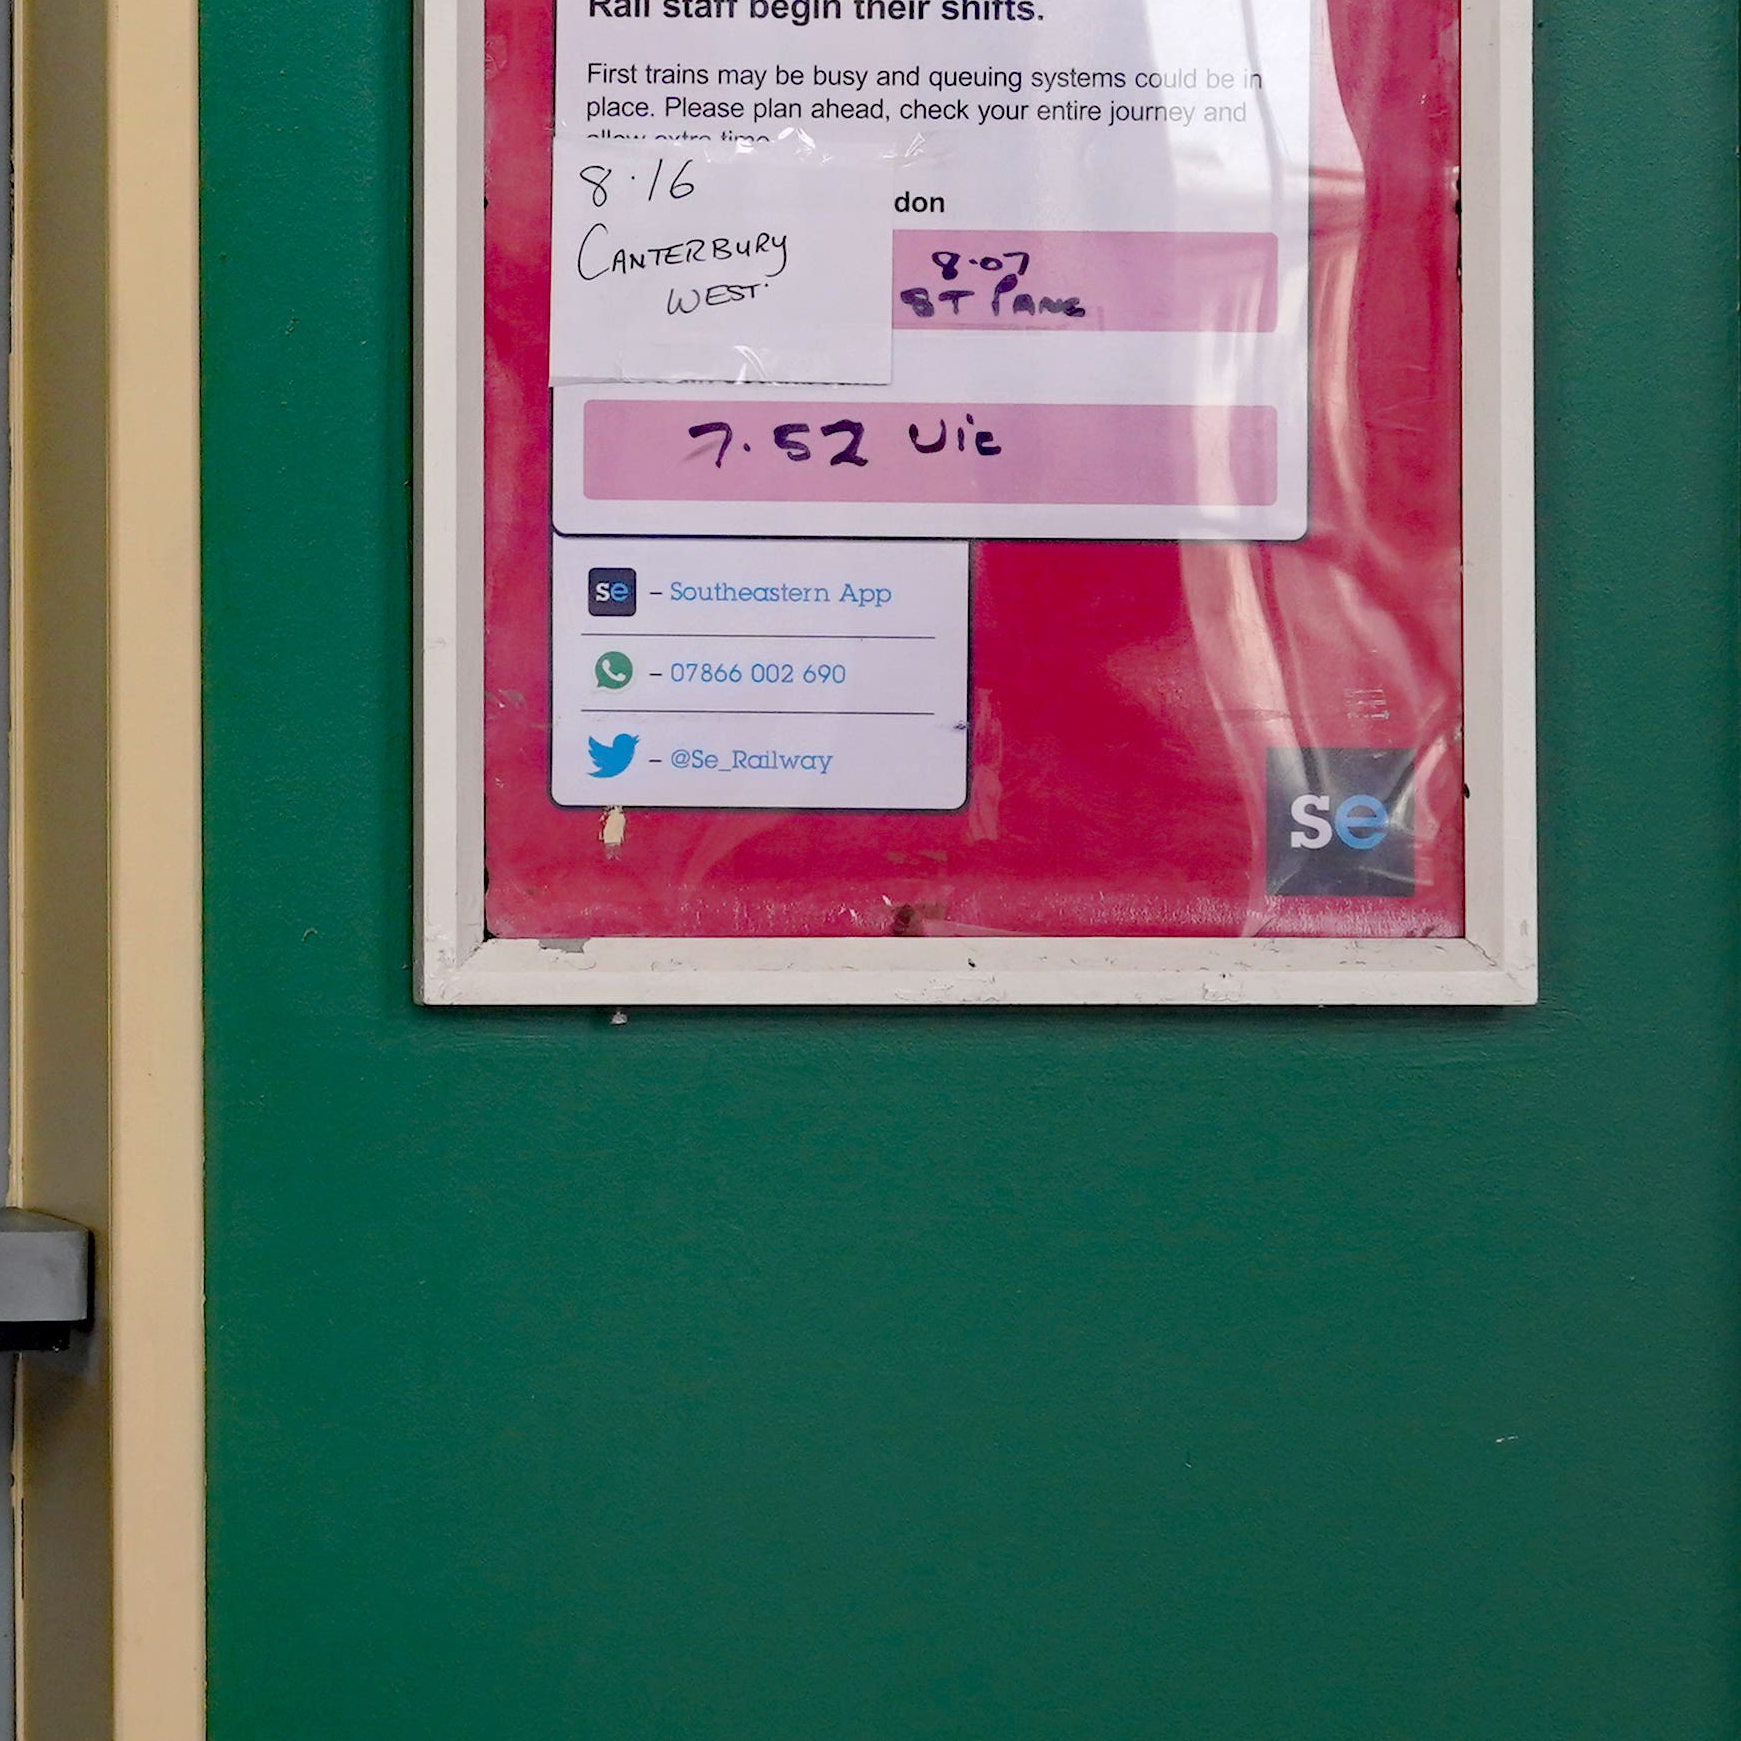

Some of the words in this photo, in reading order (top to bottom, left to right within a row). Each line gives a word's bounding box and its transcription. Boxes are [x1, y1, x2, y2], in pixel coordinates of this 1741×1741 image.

[588, 63, 637, 84] First
[647, 64, 709, 85] trains
[718, 69, 767, 90] may
[776, 64, 804, 85] be
[814, 65, 868, 91] busy
[877, 65, 919, 86] and
[929, 66, 1022, 93] queuing
[1031, 68, 1126, 93] systems
[1135, 69, 1197, 88] could
[1207, 69, 1235, 88] be
[1242, 69, 1263, 89] in
[587, 96, 654, 122] place.
[666, 96, 744, 118] Please
[754, 97, 801, 123] plan
[811, 98, 889, 122] ahead,
[900, 98, 969, 120] check
[978, 104, 1029, 126] your
[1037, 100, 1101, 121] entire
[1108, 100, 1194, 126] journey
[1204, 102, 1246, 122] and
[596, 581, 629, 602] se
[671, 582, 830, 602] Southeastern
[839, 584, 891, 607] App
[671, 663, 742, 682] 07866
[752, 664, 793, 683] 002
[803, 664, 845, 683] 690
[671, 749, 833, 774] @Se_Railway
[1290, 792, 1389, 849] se
